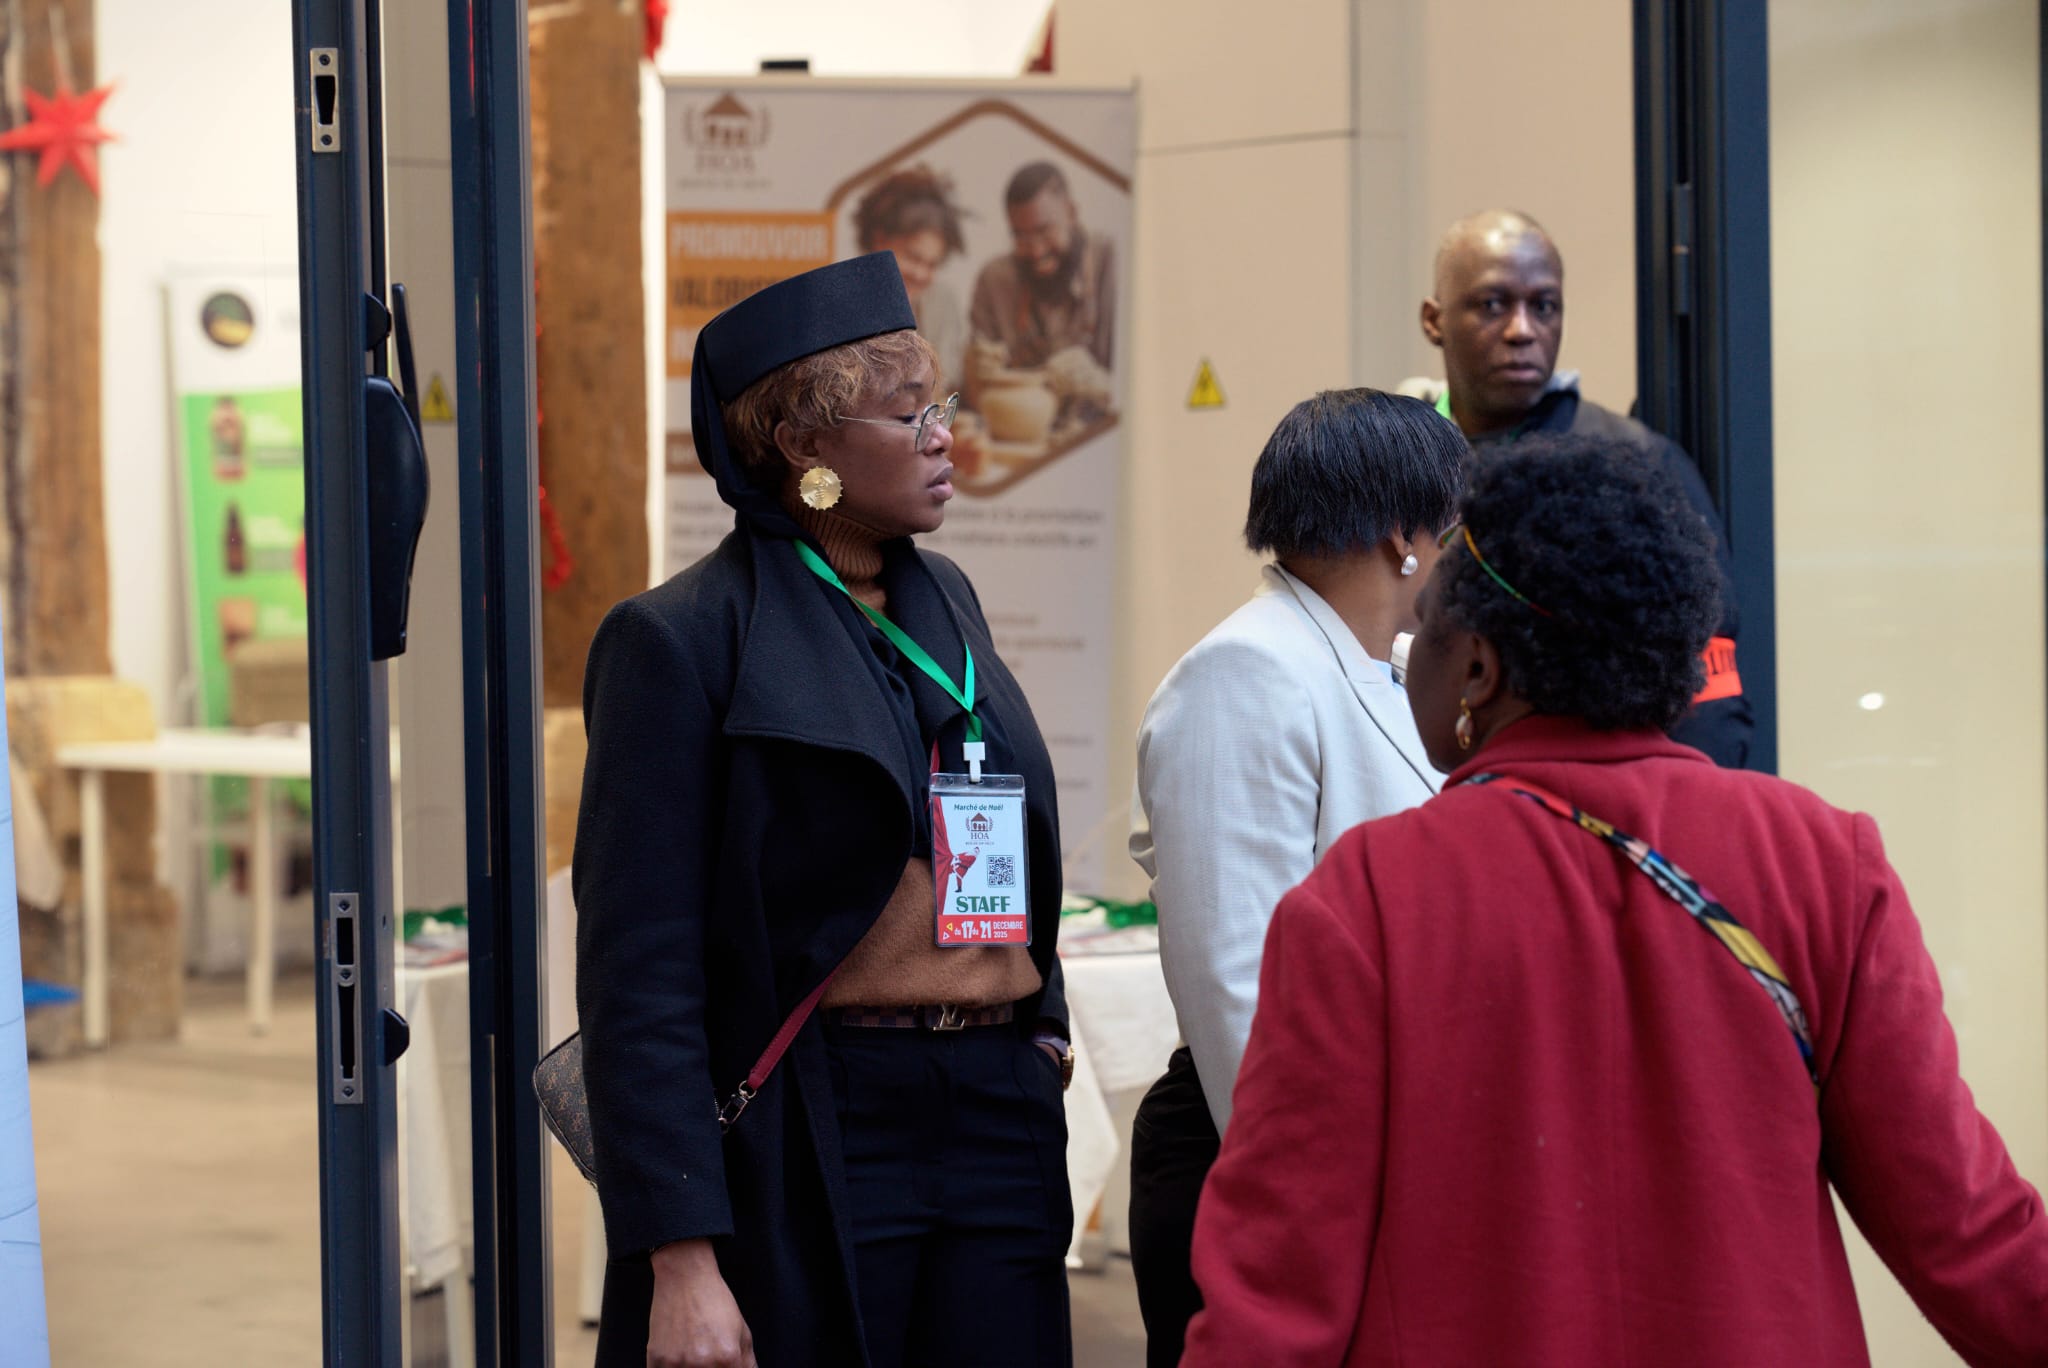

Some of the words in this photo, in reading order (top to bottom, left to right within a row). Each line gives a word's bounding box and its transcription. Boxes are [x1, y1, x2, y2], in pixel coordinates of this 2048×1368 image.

[970, 832, 990, 840] HOA
[956, 895, 1011, 913] STAFF
[954, 927, 961, 936] du
[961, 920, 974, 939] 17
[980, 920, 992, 939] 21
